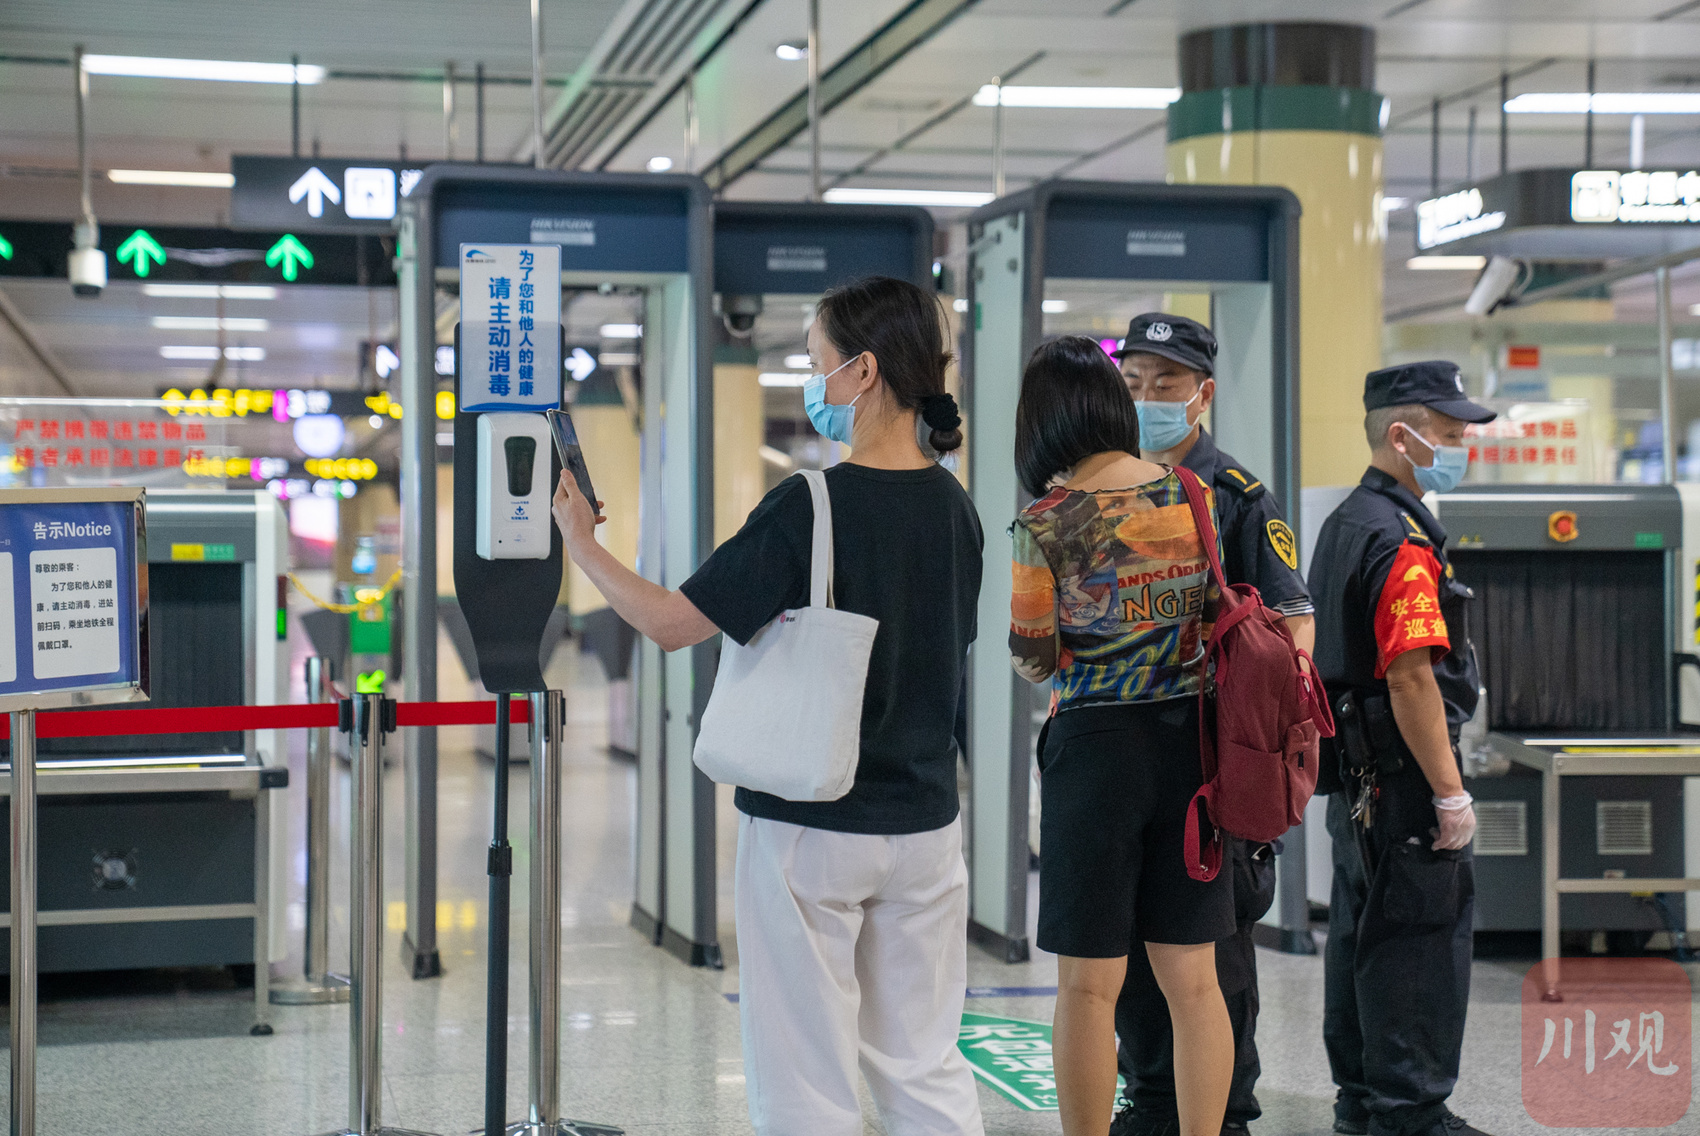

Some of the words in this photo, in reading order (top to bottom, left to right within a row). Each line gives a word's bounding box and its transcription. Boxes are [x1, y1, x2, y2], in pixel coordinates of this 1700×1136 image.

[488, 276, 511, 396] 请主动消毒
[518, 249, 534, 396] 为了您和他人的健康
[51, 579, 113, 592] 为了您和他人的健
